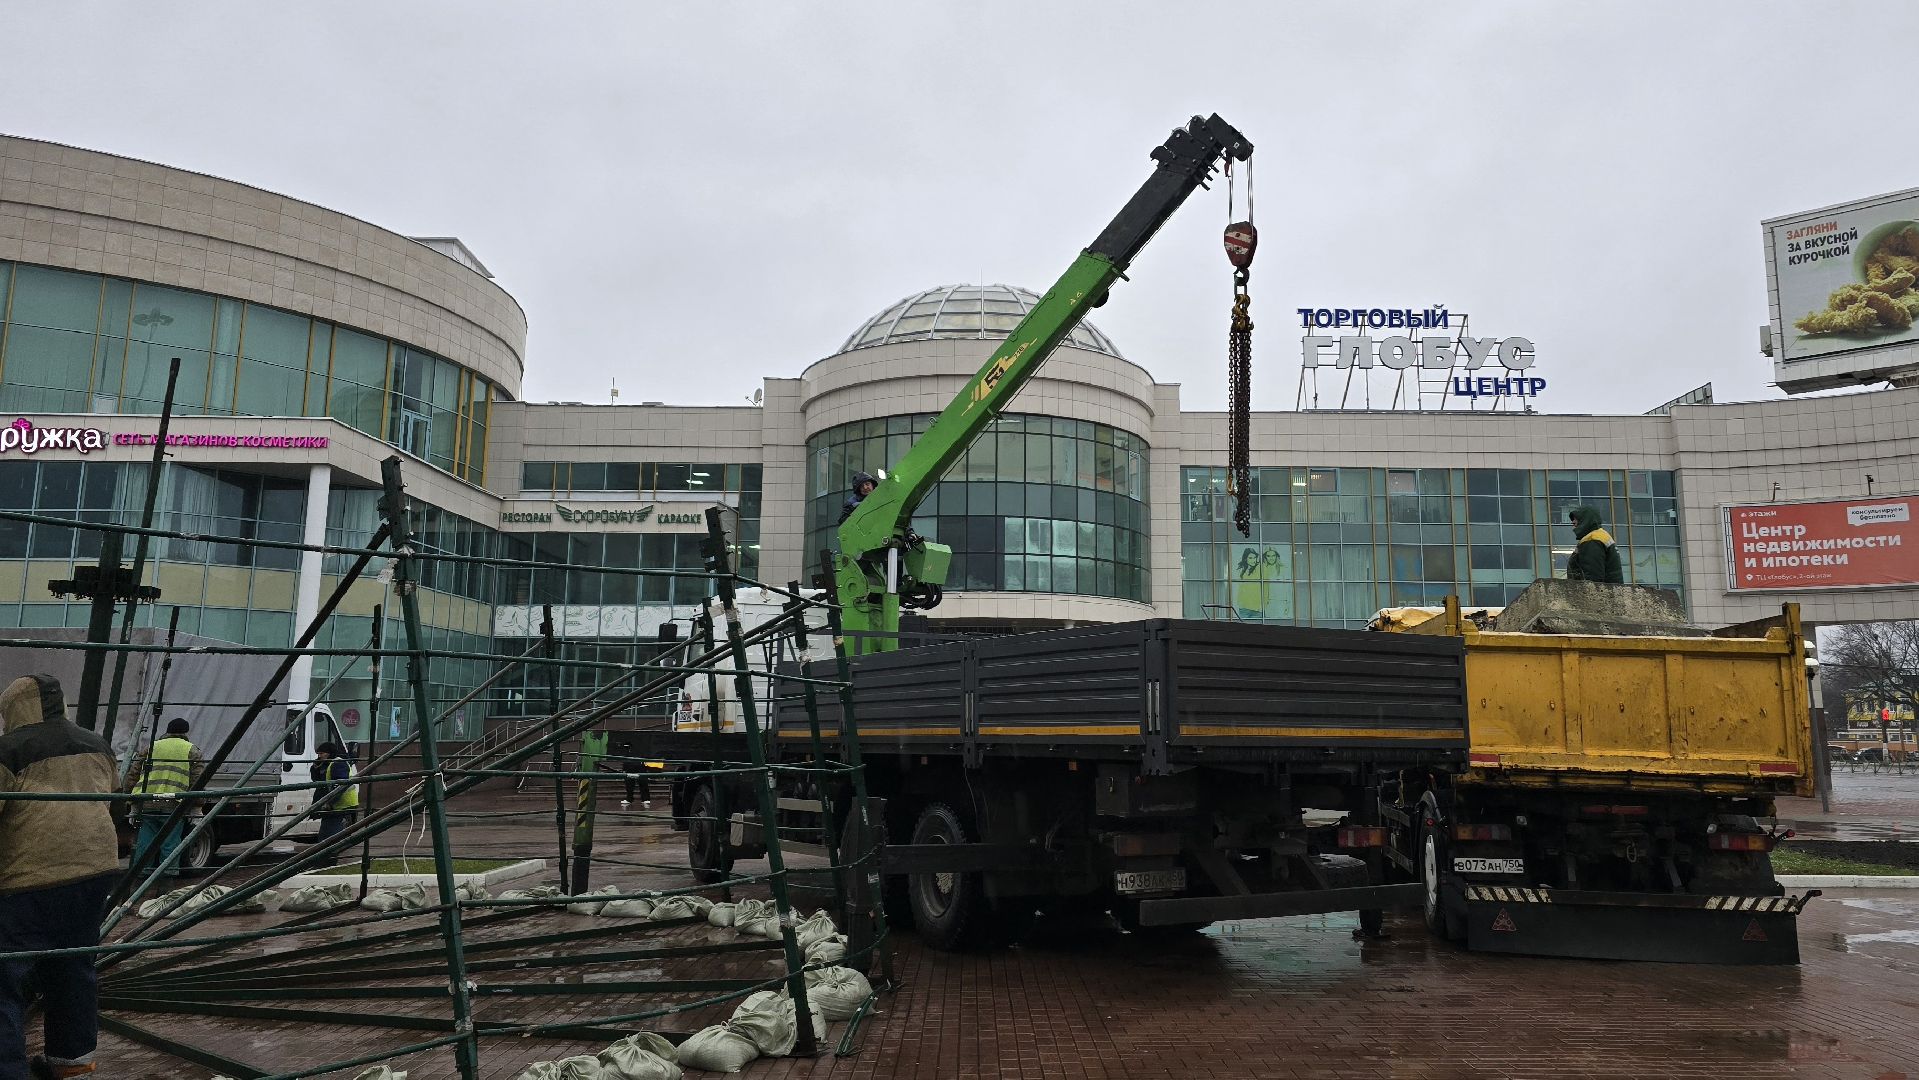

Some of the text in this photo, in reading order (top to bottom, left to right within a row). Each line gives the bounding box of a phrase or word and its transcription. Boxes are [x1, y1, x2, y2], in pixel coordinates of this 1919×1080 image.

[1786, 220, 1838, 241] ЗАГЛЯНИ
[1787, 227, 1859, 253] ЗА ВКУСНОЙ
[1788, 242, 1850, 266] КУРОЧКОЙ
[1297, 304, 1449, 328] ТОРГОВЫЙ
[1302, 336, 1536, 370] ГЛОБУС
[1453, 376, 1547, 399] ЦЕНТР
[112, 433, 146, 446] СЕТЬ
[243, 435, 329, 449] КОСМЕТИКИ
[502, 512, 552, 523] РЕСТОРАН
[657, 513, 702, 524] КАРАОКЕ
[1742, 522, 1807, 540] Центр
[1743, 534, 1901, 554] недвижимости
[1744, 553, 1849, 568] и ипотеки
